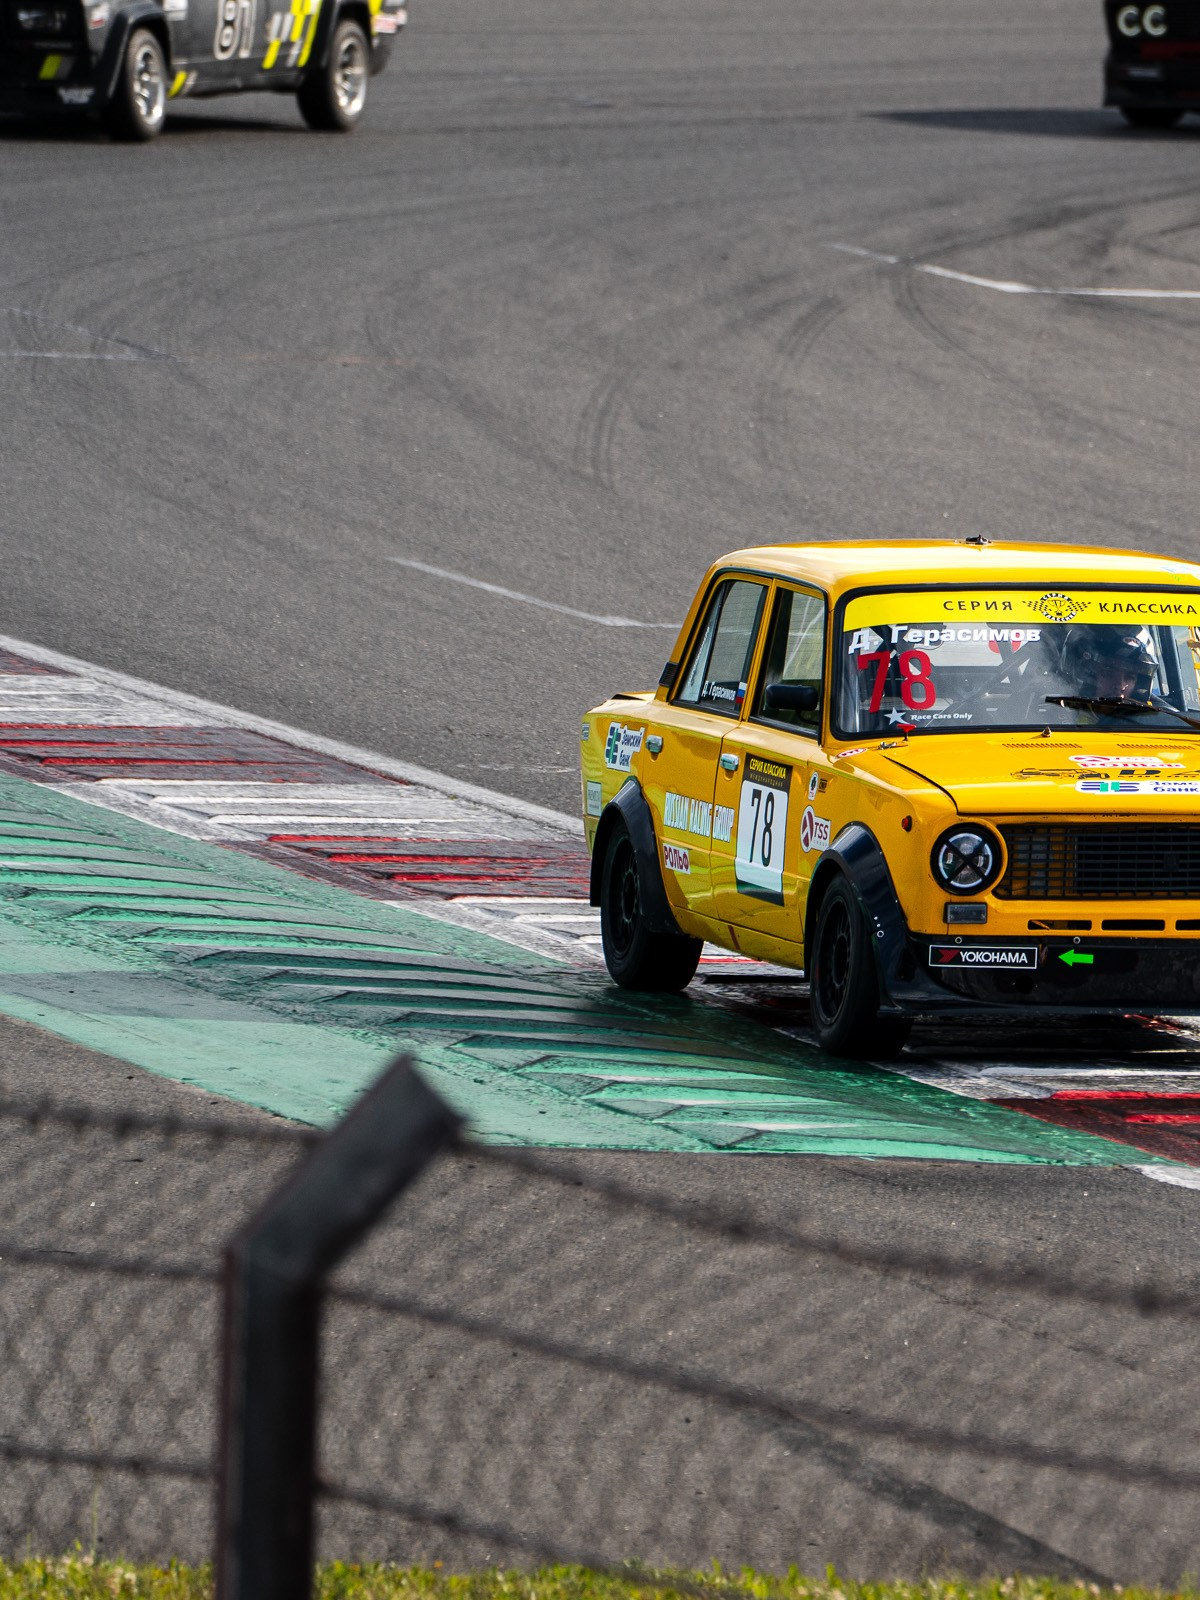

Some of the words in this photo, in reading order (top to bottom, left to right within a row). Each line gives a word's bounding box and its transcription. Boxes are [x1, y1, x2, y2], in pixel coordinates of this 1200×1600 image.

[943, 600, 1012, 611] СЕРИЯ
[1099, 602, 1198, 614] КЛАССИКА
[848, 631, 879, 654] Д.
[887, 624, 1042, 648] Герасимов
[857, 649, 936, 713] 78
[911, 713, 932, 722] Race
[953, 712, 973, 721] Only
[664, 791, 689, 831] RUSSIAN
[713, 804, 735, 843] GROUP
[749, 788, 775, 867] 78
[813, 821, 829, 841] TSS
[664, 845, 690, 871] РОЛЬФ
[960, 951, 1028, 964] YOKOHAMA
